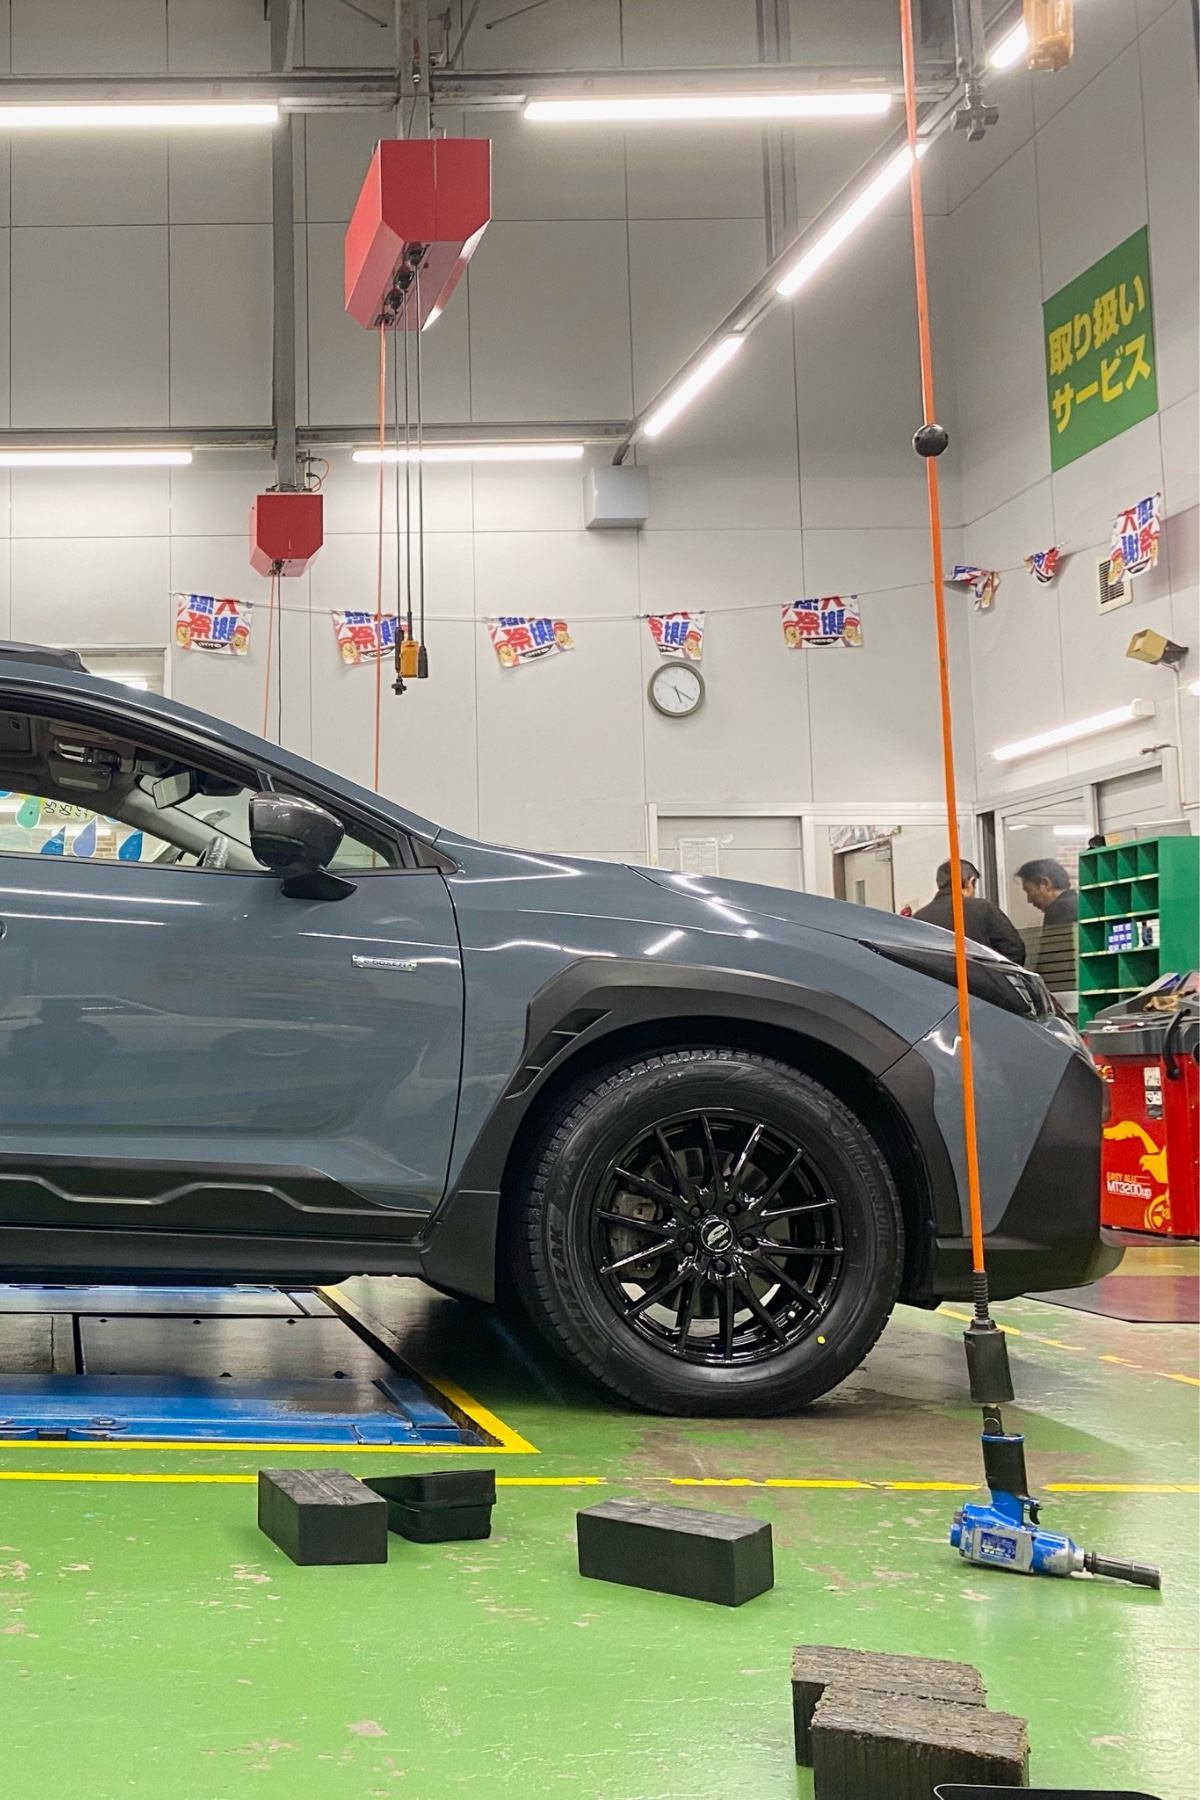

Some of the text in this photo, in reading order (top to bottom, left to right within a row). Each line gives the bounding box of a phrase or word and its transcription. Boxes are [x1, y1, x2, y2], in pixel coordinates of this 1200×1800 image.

[1049, 275, 1146, 375] 取り扱い
[1052, 334, 1151, 433] サービス
